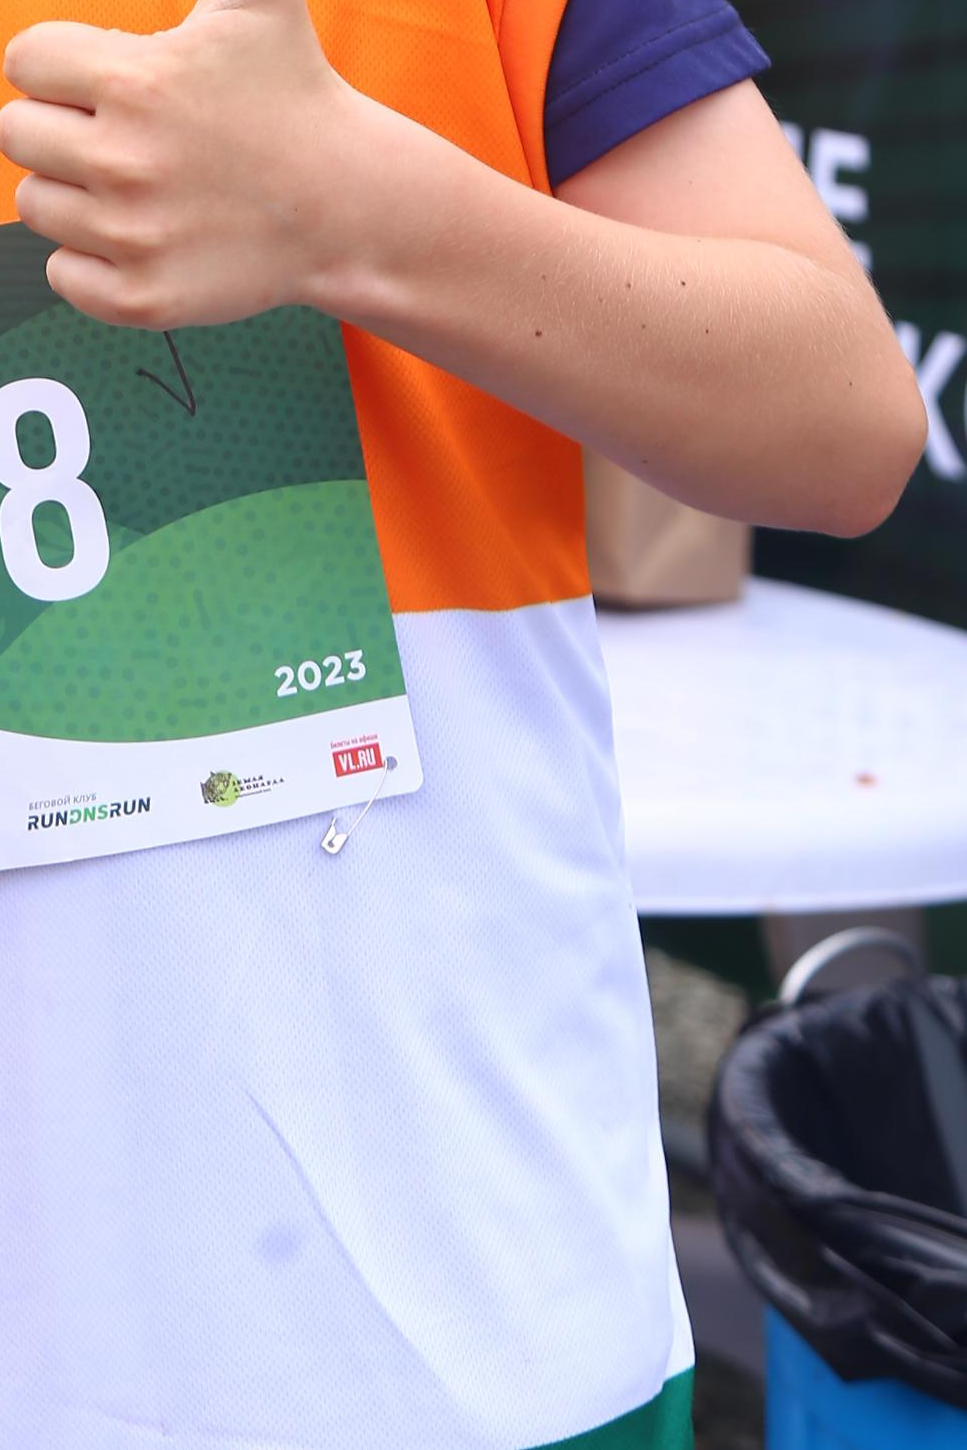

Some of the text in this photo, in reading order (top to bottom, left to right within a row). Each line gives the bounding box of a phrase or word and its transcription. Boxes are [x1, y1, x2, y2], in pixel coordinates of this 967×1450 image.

[274, 649, 366, 697] 2023
[338, 747, 376, 772] VL.RU
[28, 793, 97, 811] БЕГОВОЙ КЛУБ
